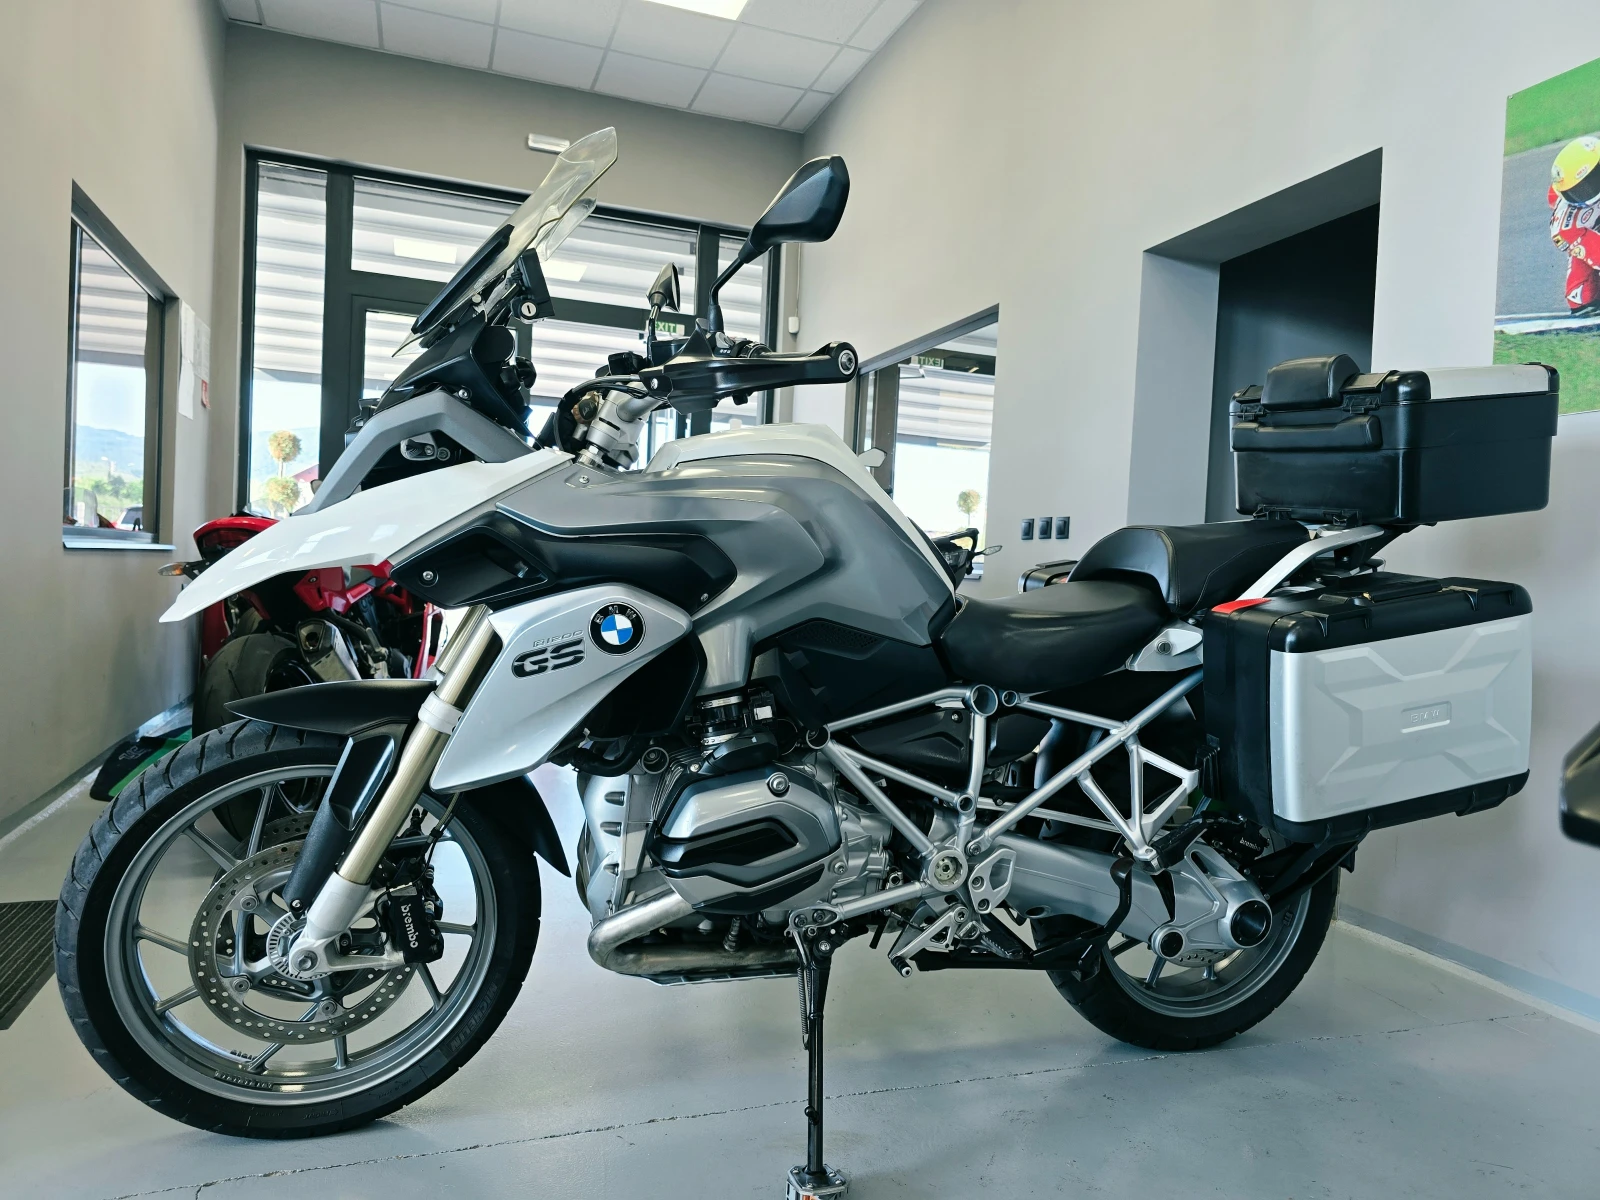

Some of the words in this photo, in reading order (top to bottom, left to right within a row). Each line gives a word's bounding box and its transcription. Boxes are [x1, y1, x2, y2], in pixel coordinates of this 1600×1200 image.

[655, 321, 676, 333] XIT
[594, 604, 637, 625] BMW
[511, 638, 586, 679] GS
[1239, 836, 1261, 852] brembo
[400, 903, 419, 949] brembo
[449, 981, 499, 1053] MICHELIN
